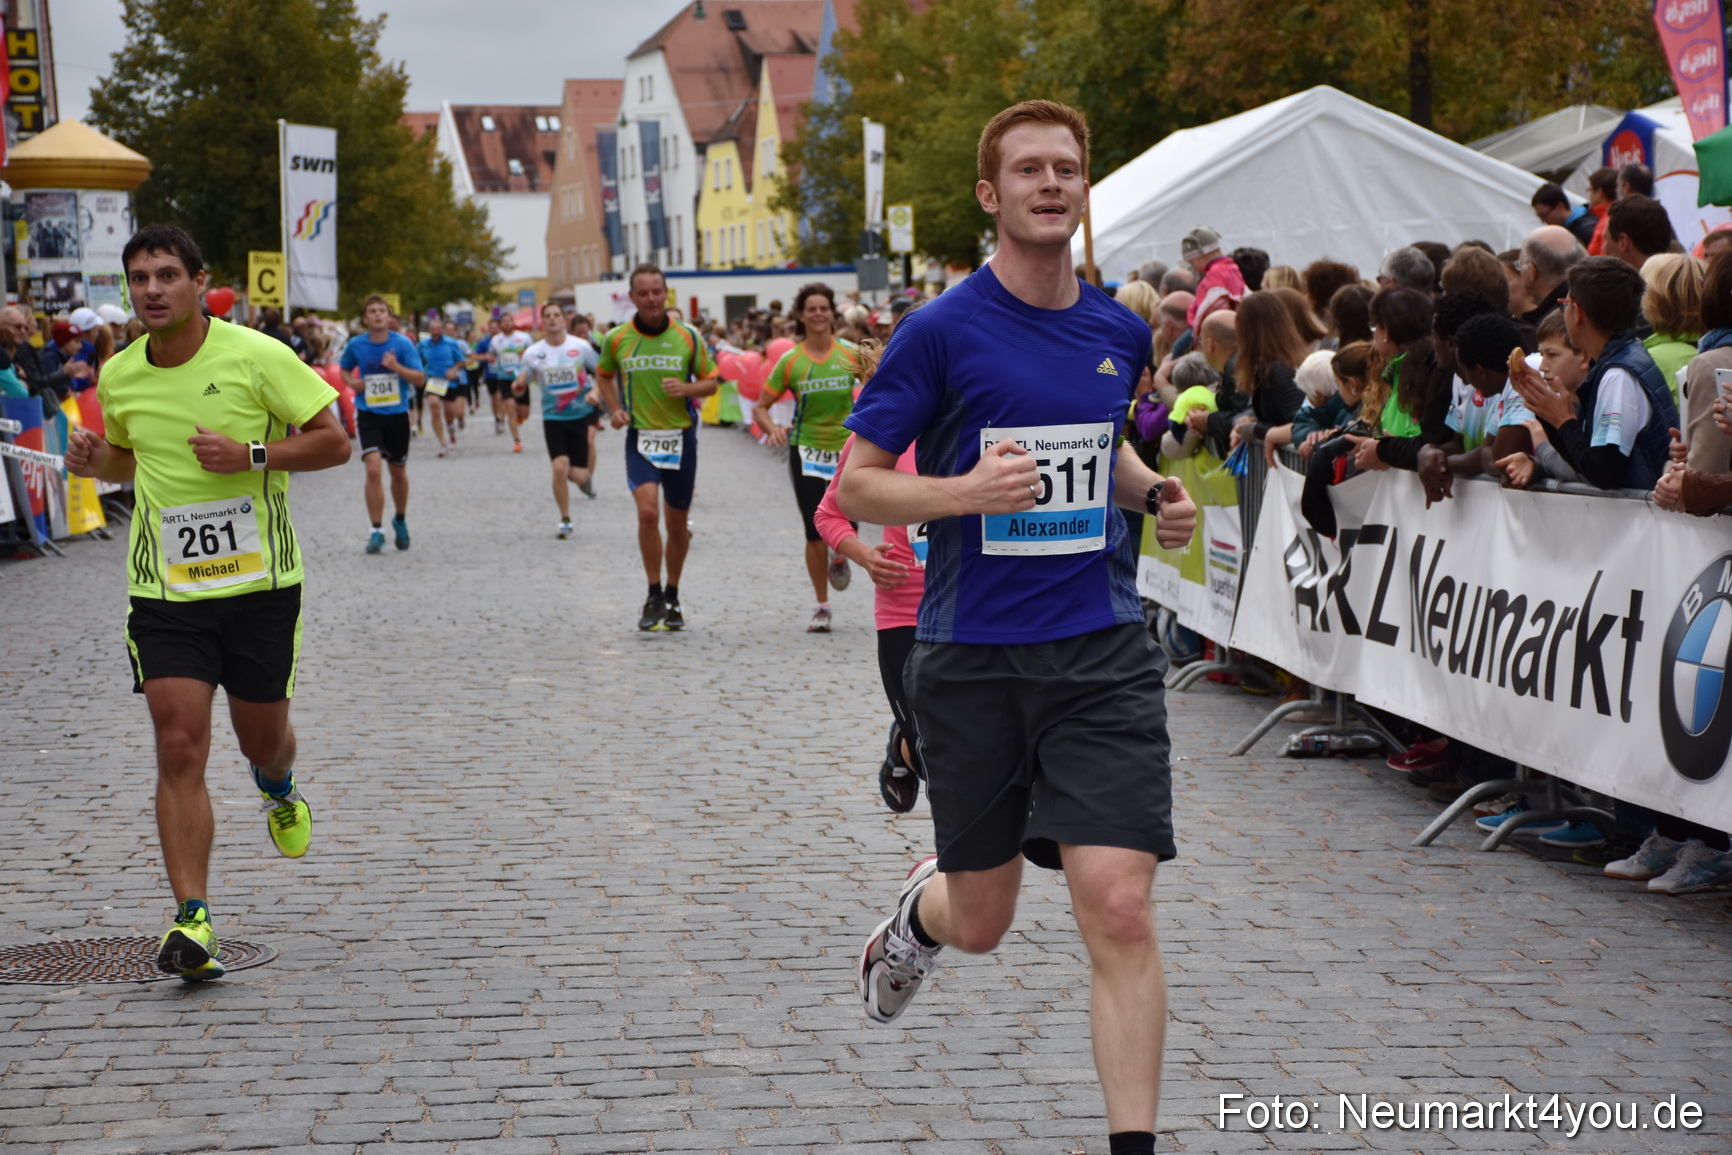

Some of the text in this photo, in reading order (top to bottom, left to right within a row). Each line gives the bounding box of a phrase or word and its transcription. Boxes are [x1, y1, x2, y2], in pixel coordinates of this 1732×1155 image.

[7, 31, 40, 129] HOT
[290, 155, 335, 173] swn
[253, 254, 281, 265] Block
[257, 268, 277, 294] C
[622, 355, 682, 372] BOCK
[1096, 367, 1118, 376] adidas
[371, 381, 393, 395] 204
[798, 377, 849, 393] BOCK
[642, 439, 679, 453] 2792
[1035, 437, 1094, 451] Neumarkt
[804, 447, 840, 464] 2791
[190, 508, 238, 521] Neumarkt
[1008, 517, 1090, 537] Alexander
[178, 520, 238, 558] 261
[188, 560, 240, 579] Michael
[1410, 534, 1645, 723] Neumarkt
